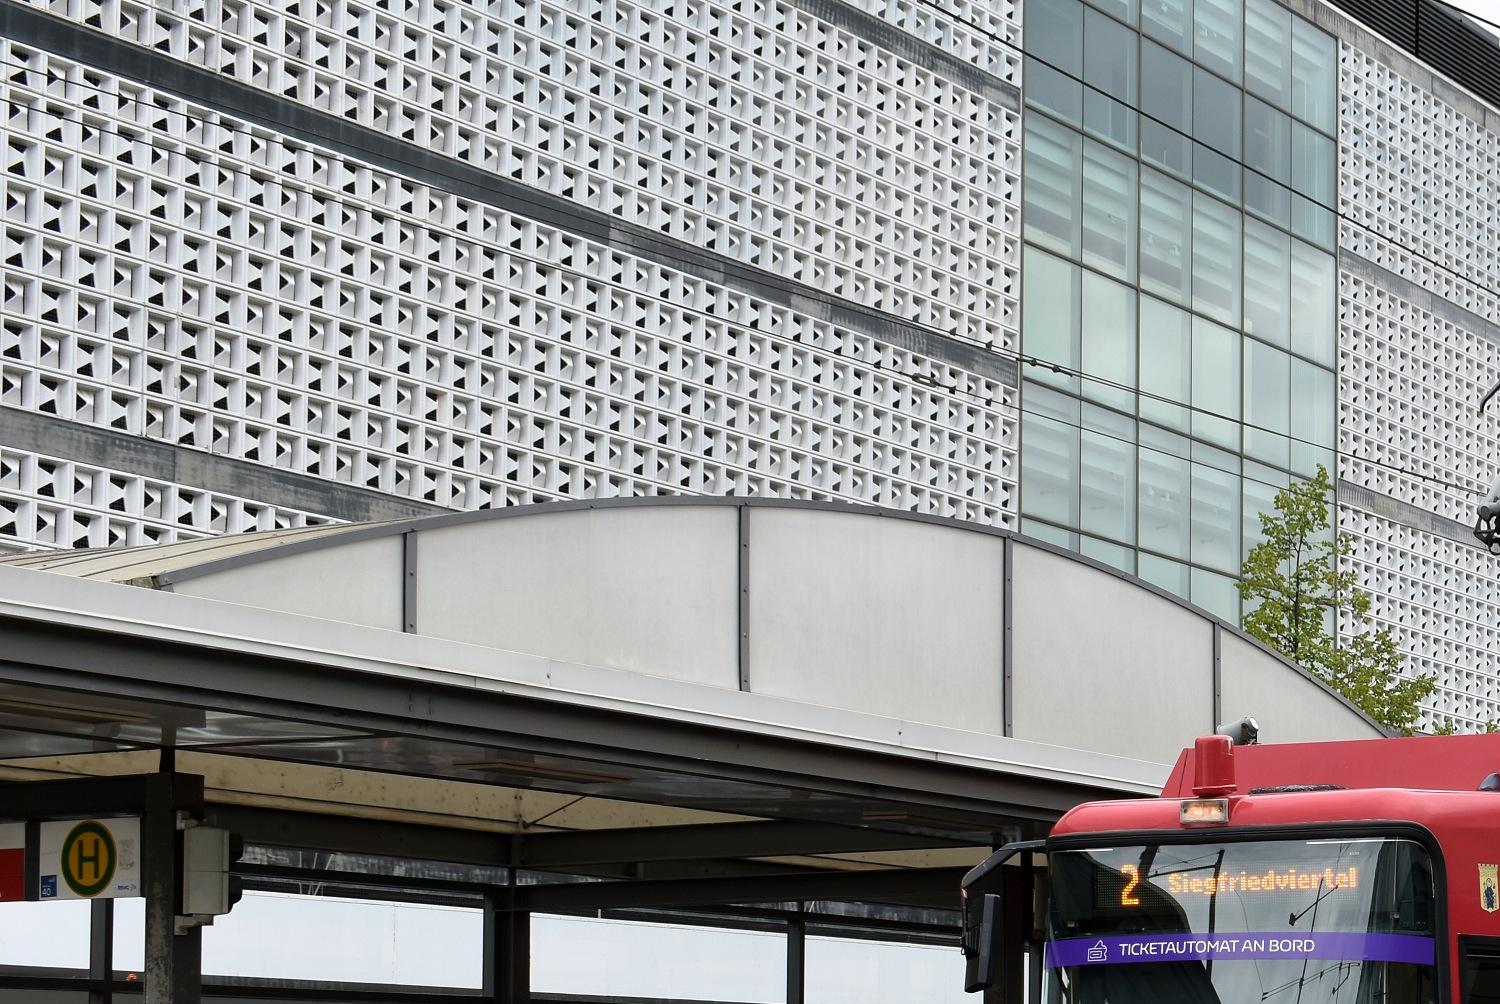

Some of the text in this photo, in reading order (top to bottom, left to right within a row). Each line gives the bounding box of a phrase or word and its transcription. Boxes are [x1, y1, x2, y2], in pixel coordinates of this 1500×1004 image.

[1120, 864, 1358, 905] 2 Siegfriedviertel
[1118, 939, 1316, 956] TICKETAUTOMAT AN BORD
